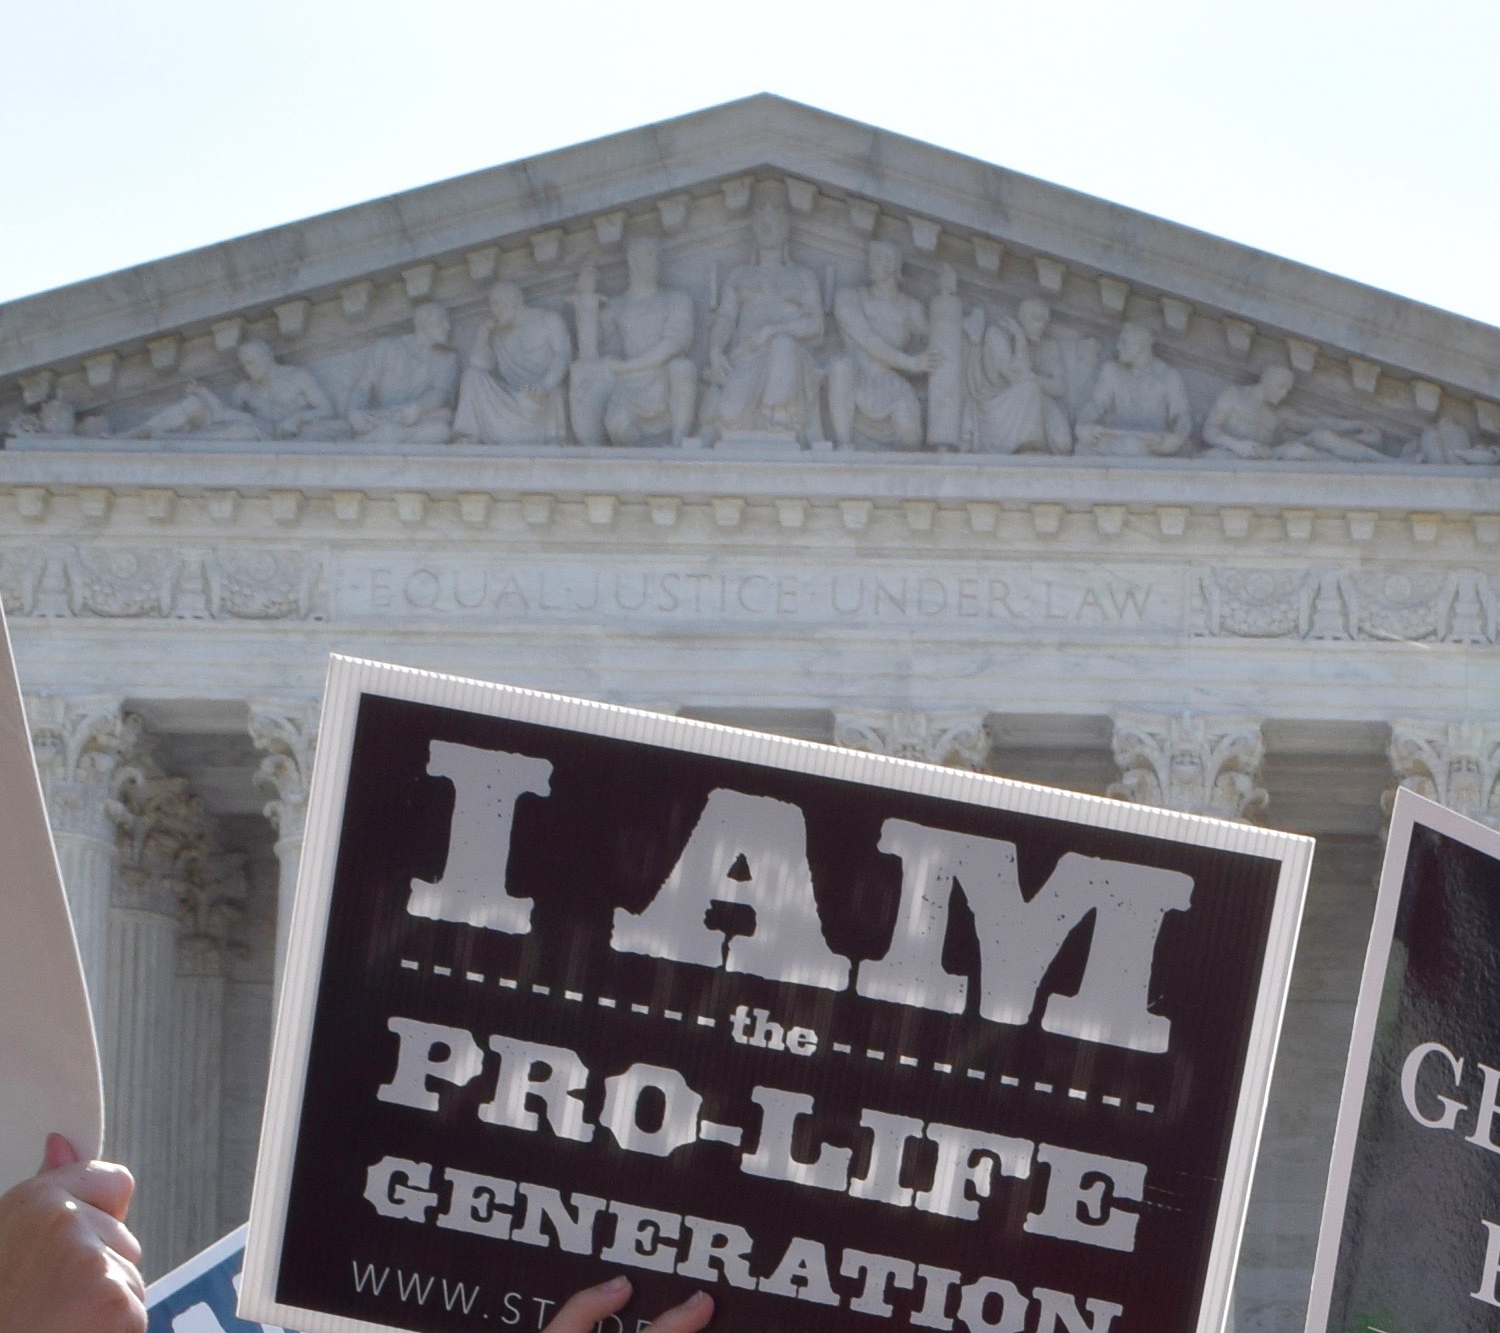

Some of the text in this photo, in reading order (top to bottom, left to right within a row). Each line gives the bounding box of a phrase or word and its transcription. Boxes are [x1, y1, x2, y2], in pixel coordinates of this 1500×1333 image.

[369, 566, 1151, 622] EQUAL JUSTICE UNDER LAW
[406, 739, 1195, 1054] I AM
[728, 1004, 820, 1057] the
[376, 1015, 1149, 1252] PRO-LIFE
